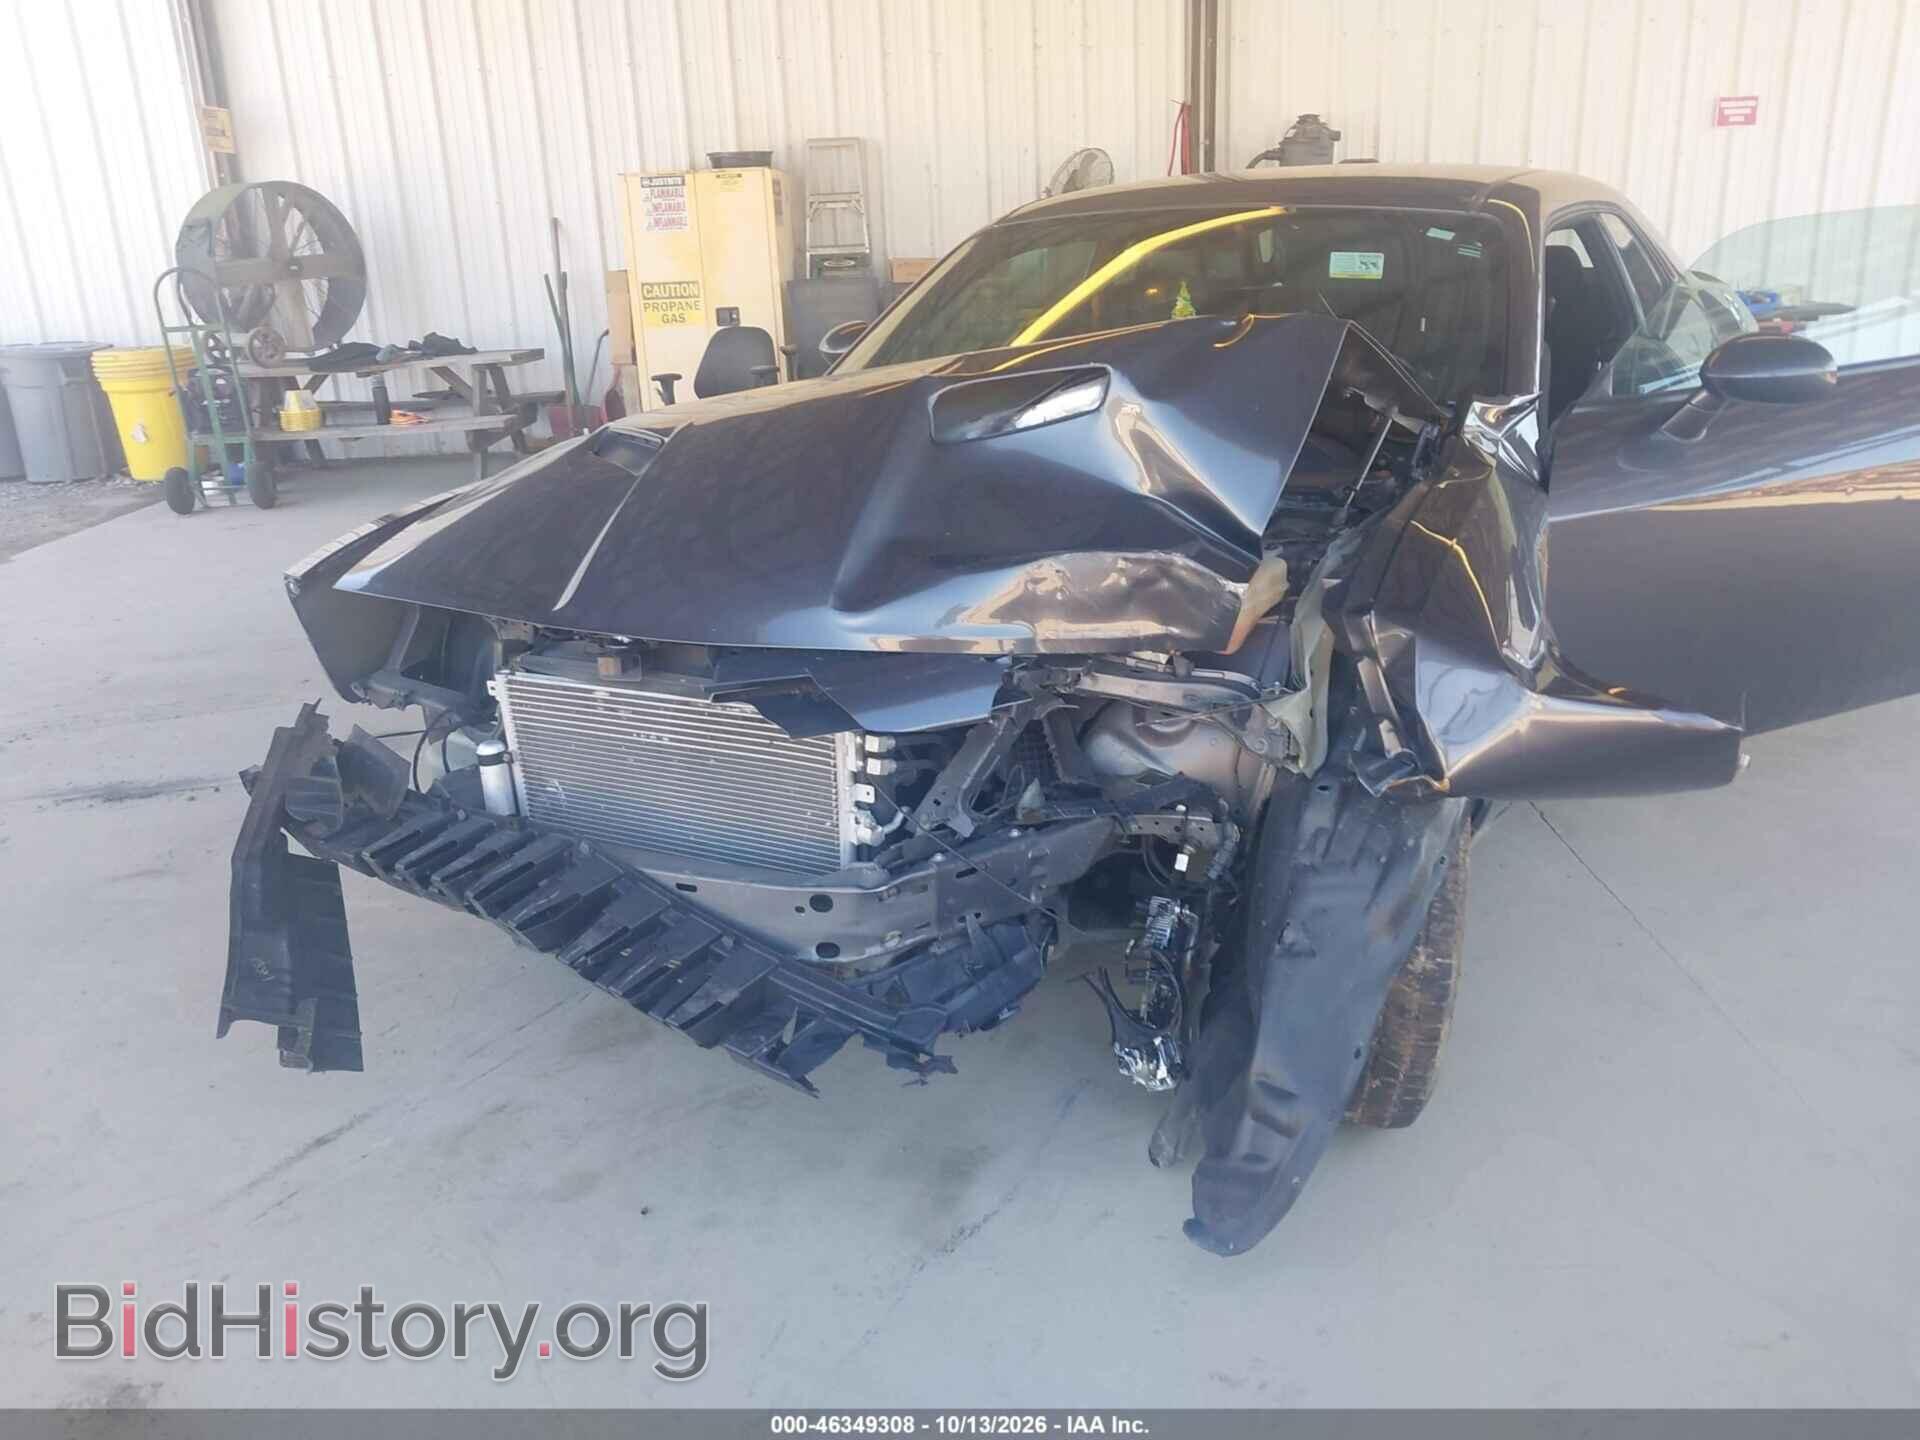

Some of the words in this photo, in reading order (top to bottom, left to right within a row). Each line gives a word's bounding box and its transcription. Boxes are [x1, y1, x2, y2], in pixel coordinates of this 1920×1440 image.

[643, 283, 699, 298] CAUTION
[643, 300, 701, 312] PROPANE
[661, 312, 686, 324] GAS
